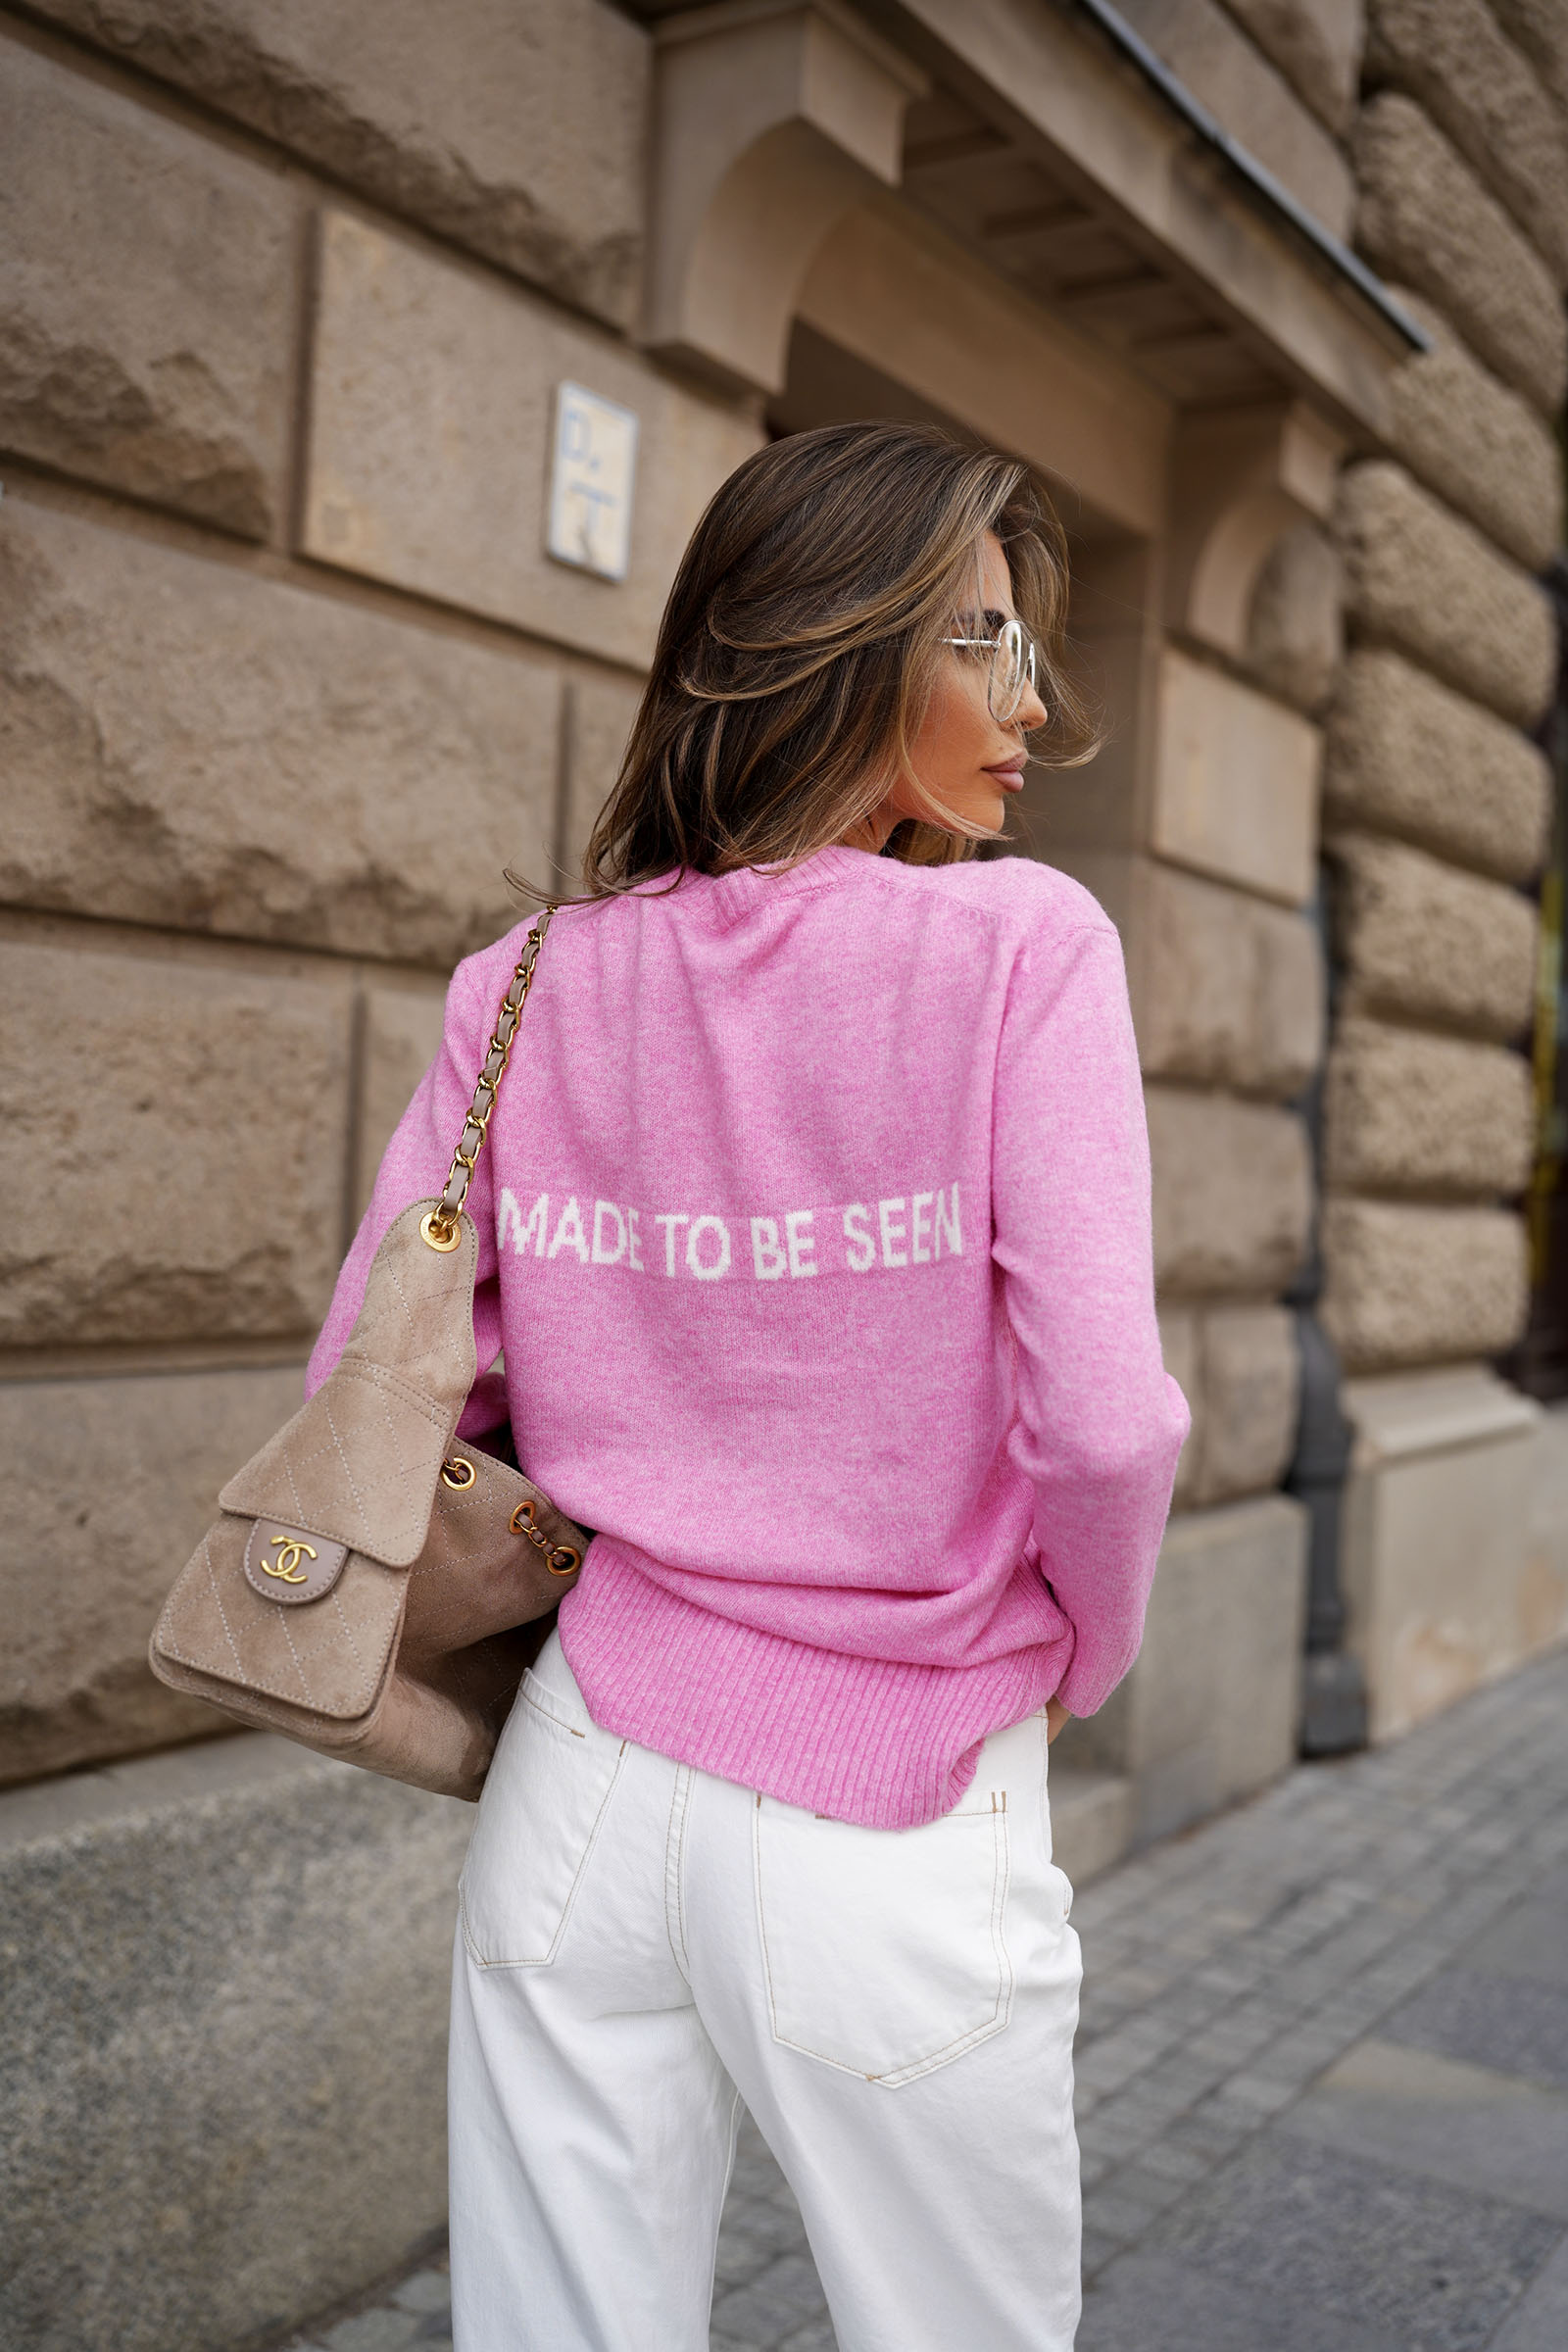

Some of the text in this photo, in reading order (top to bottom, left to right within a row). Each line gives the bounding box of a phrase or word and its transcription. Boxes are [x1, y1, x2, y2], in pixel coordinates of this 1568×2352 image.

[498, 1182, 963, 1281] MADE TO BE SEEN
